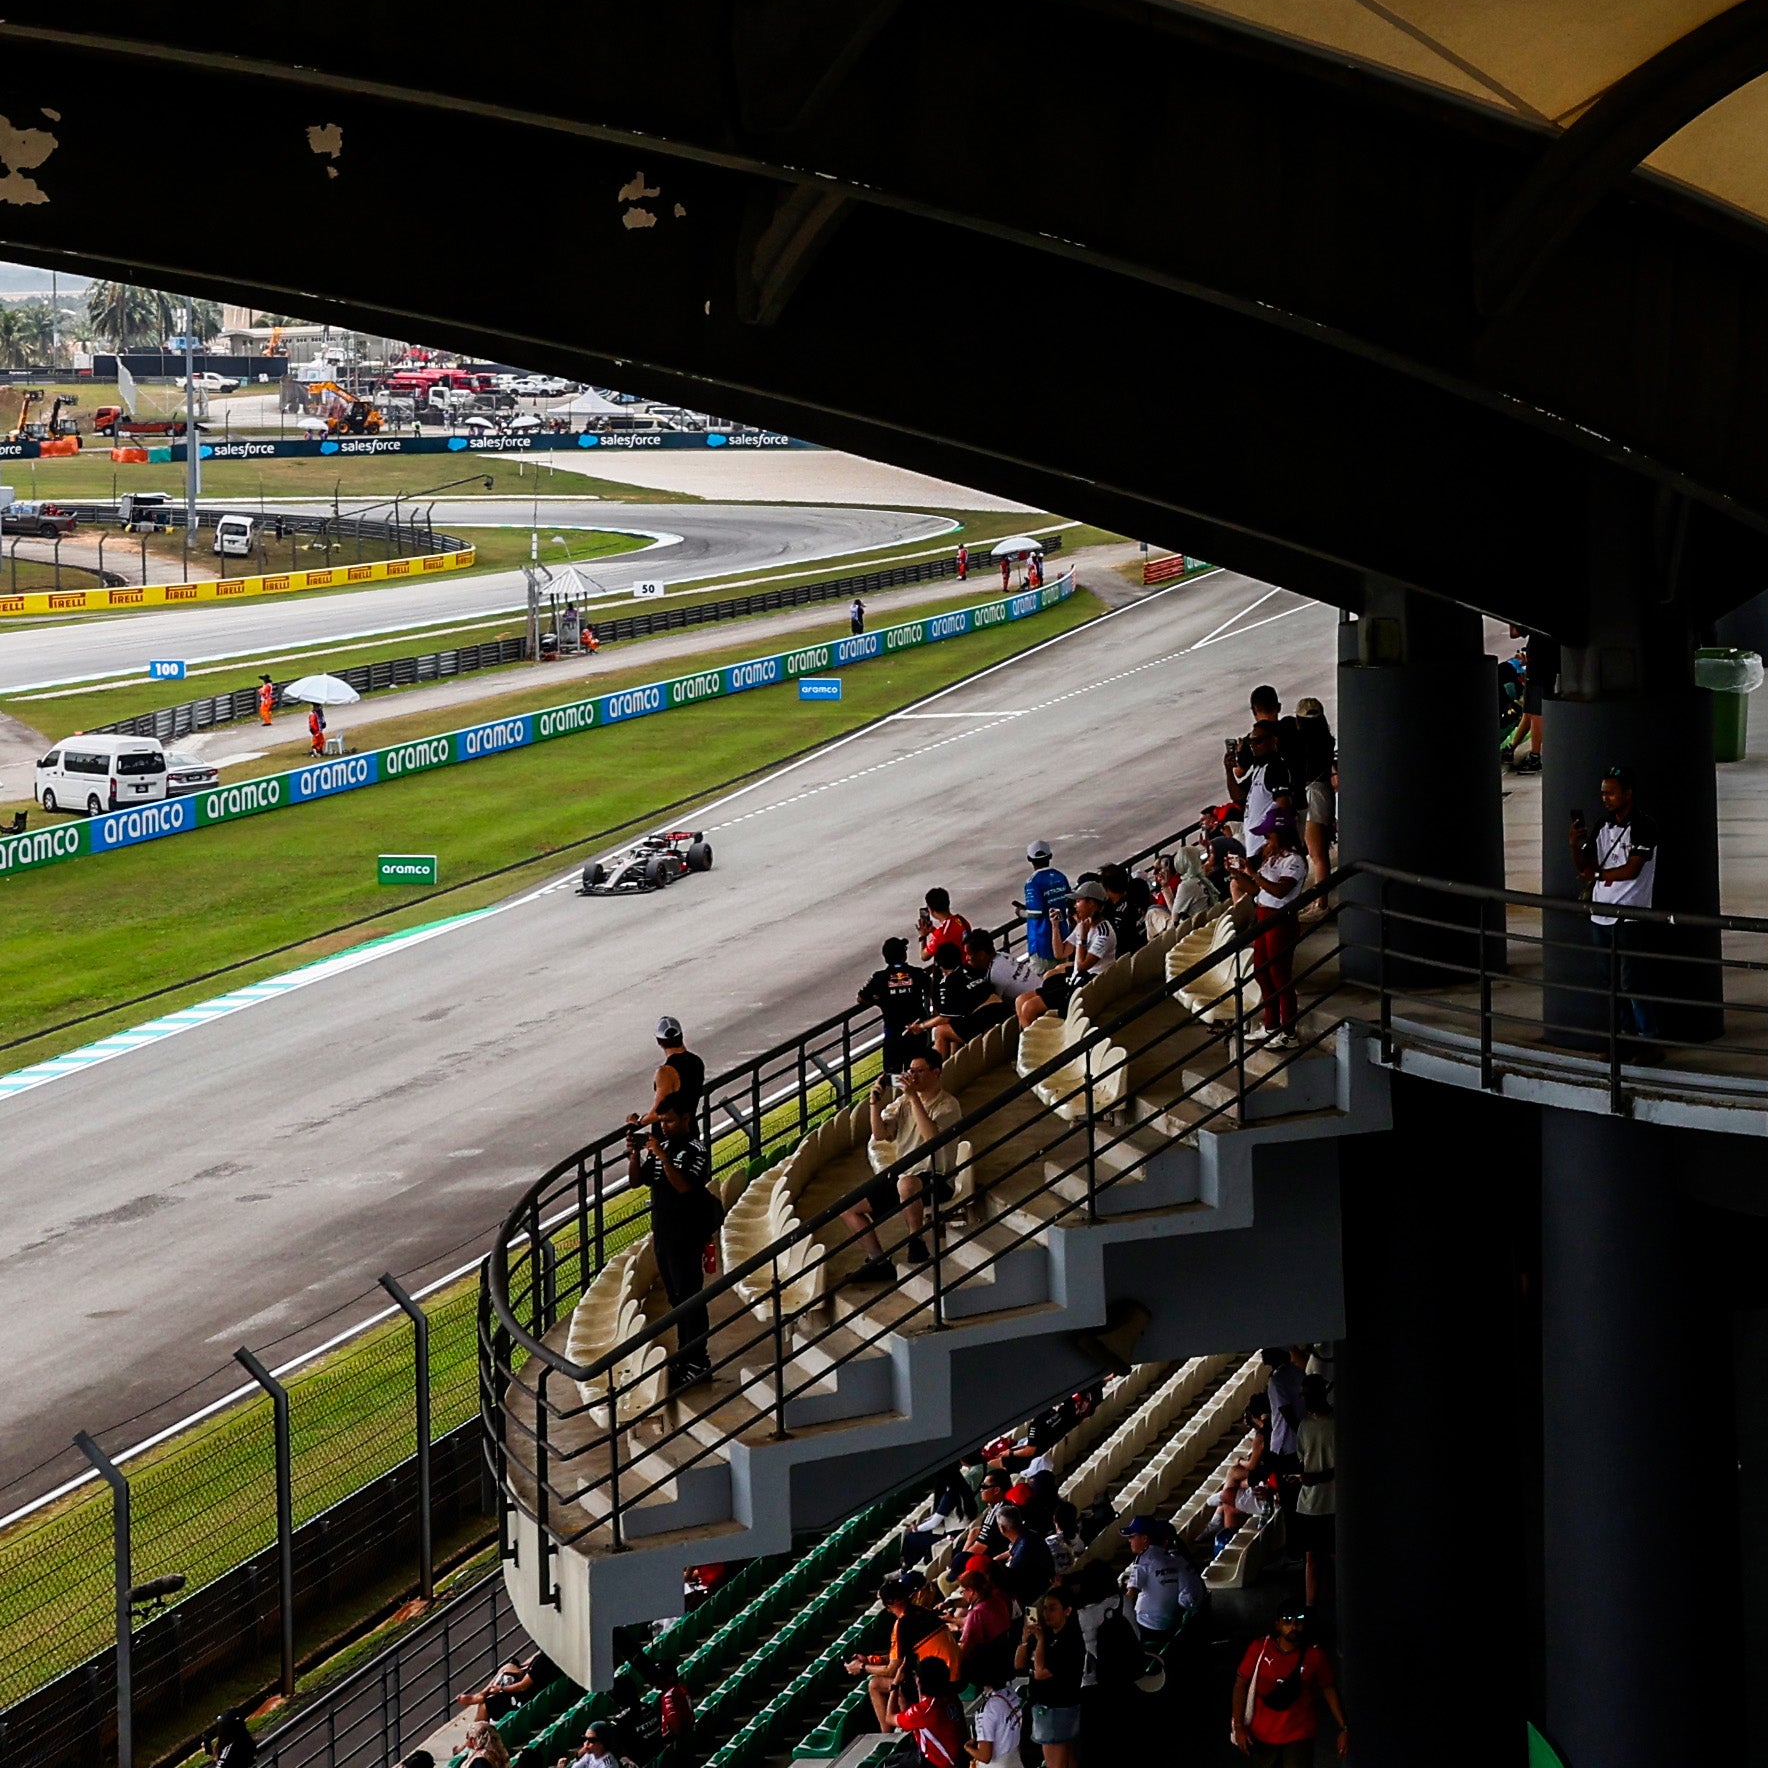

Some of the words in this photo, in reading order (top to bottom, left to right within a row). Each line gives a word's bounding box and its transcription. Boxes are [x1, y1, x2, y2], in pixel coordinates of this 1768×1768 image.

[341, 438, 400, 453] salesforce
[470, 435, 531, 449] salesforce
[600, 434, 661, 447] salesforce
[728, 434, 788, 447] salesforce
[214, 442, 275, 457] salesforce
[387, 561, 409, 575] PIRELLI
[423, 556, 444, 570] PIRELLI
[306, 570, 332, 586] PIRELLI
[348, 566, 372, 581] PIRELLI
[216, 580, 245, 596] PIRELLI
[262, 575, 290, 591] PIRELLI
[642, 584, 655, 594] 50
[109, 588, 144, 604] PIRELLI
[165, 584, 197, 600] PIRELLI
[48, 592, 86, 609] PIRELLI
[974, 603, 1006, 626] aramco
[932, 613, 966, 637] aramco
[887, 624, 923, 649] aramco
[839, 635, 877, 660] aramco
[787, 647, 828, 674] aramco
[155, 663, 179, 676] 100
[732, 660, 776, 688] aramco
[673, 673, 720, 702] aramco
[801, 685, 838, 694] aramco
[609, 687, 659, 718] aramco
[540, 703, 594, 736] aramco
[466, 721, 523, 754] aramco
[387, 738, 449, 774] aramco
[300, 758, 368, 795] aramco
[206, 779, 280, 819] aramco
[104, 803, 184, 844] aramco
[382, 865, 430, 875] aramco
